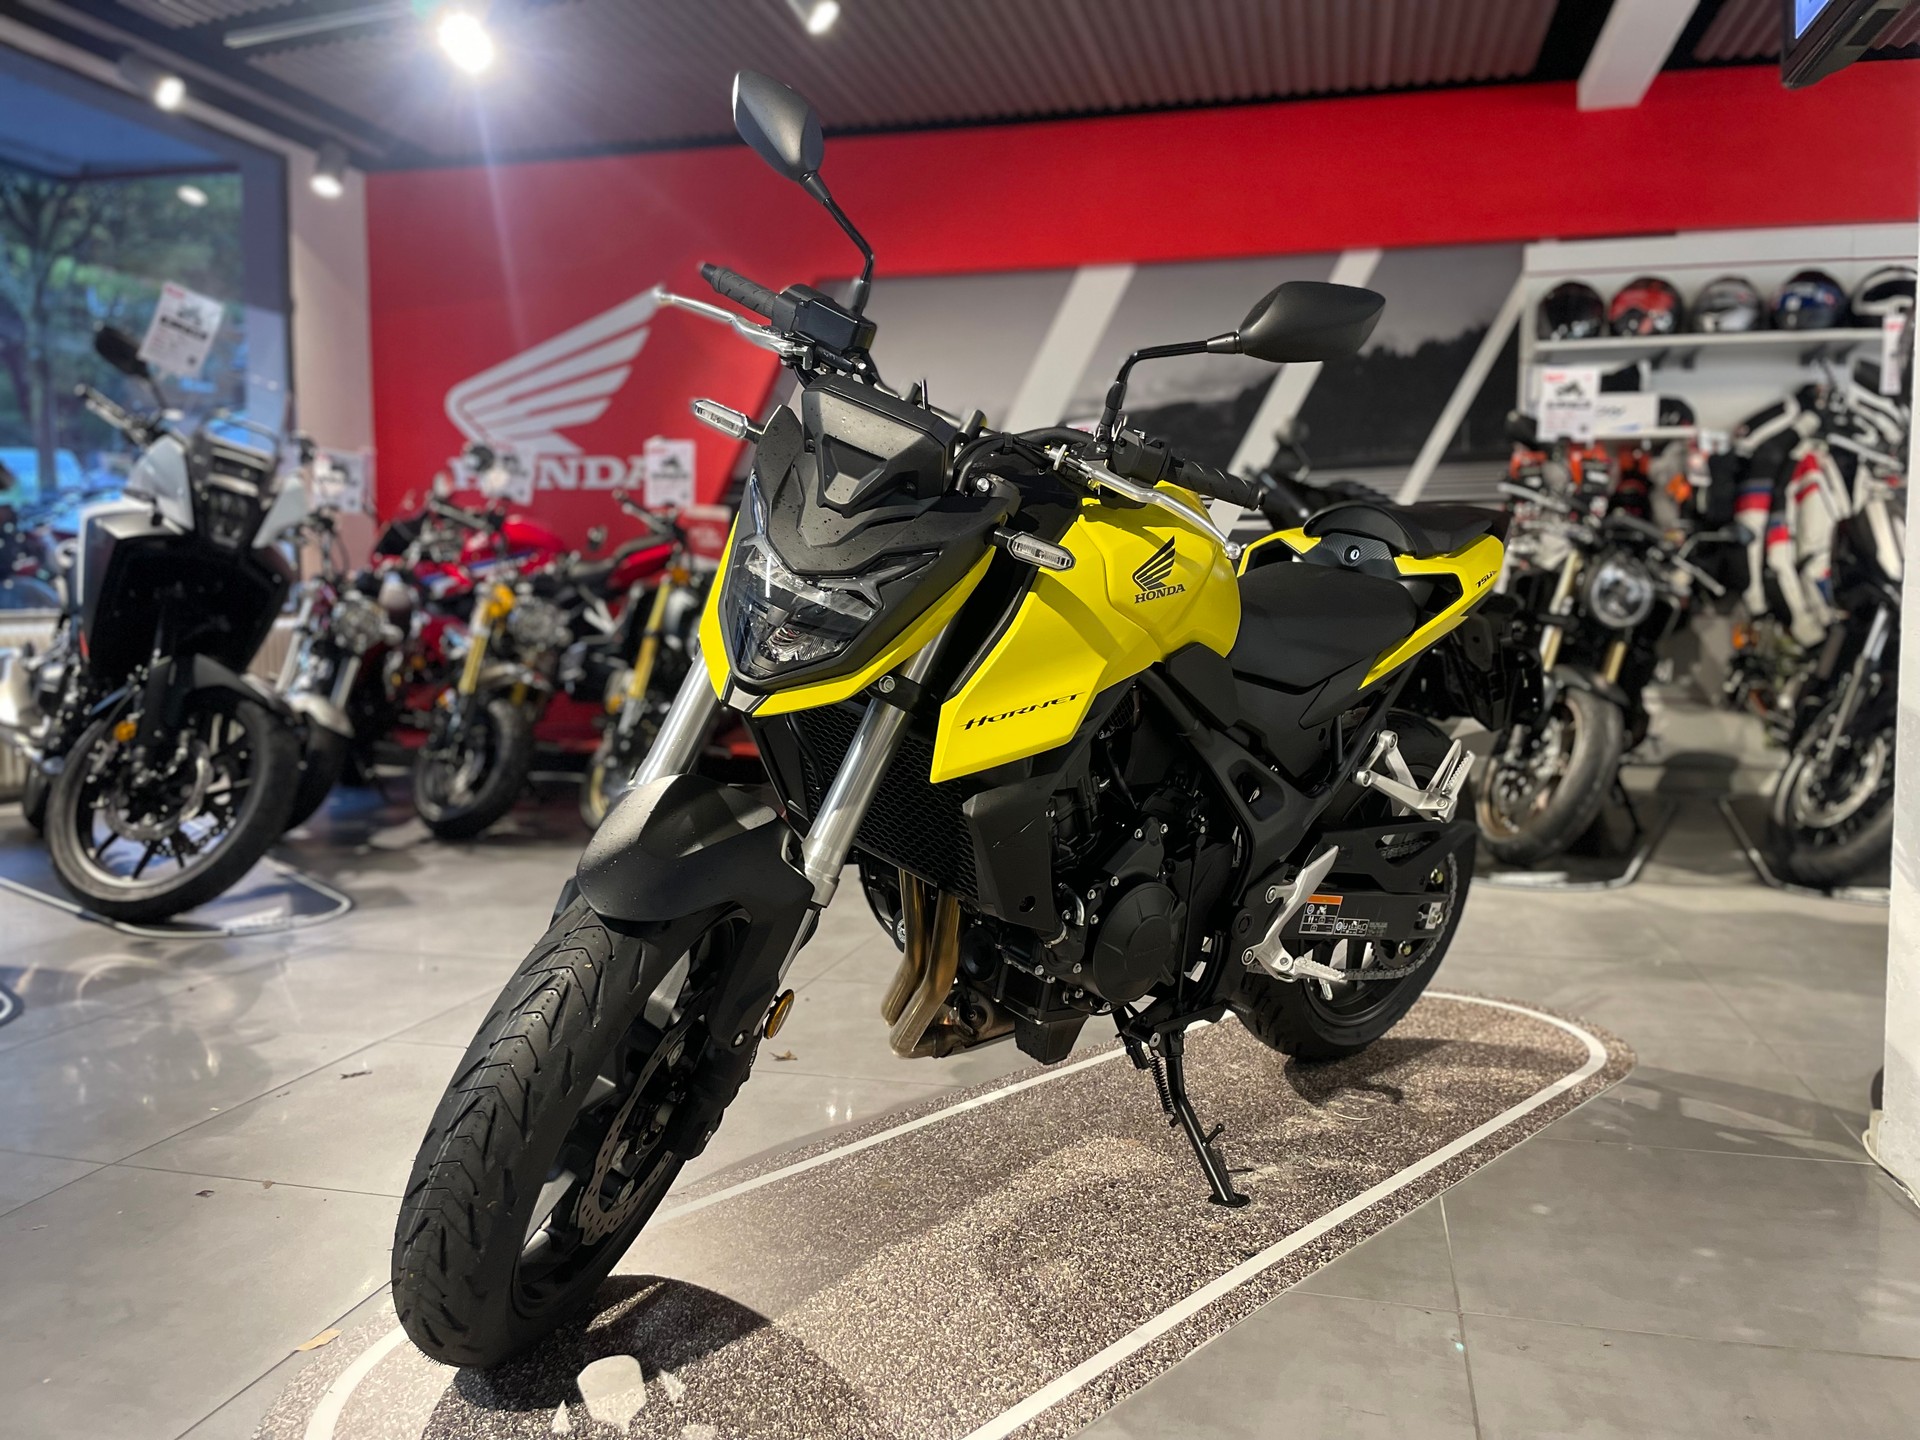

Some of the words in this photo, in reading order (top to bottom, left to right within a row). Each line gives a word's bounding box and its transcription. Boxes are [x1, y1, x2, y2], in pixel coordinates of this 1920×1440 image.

[447, 455, 648, 491] HND
[1134, 583, 1186, 604] HONDA
[958, 691, 1085, 731] HORNET
